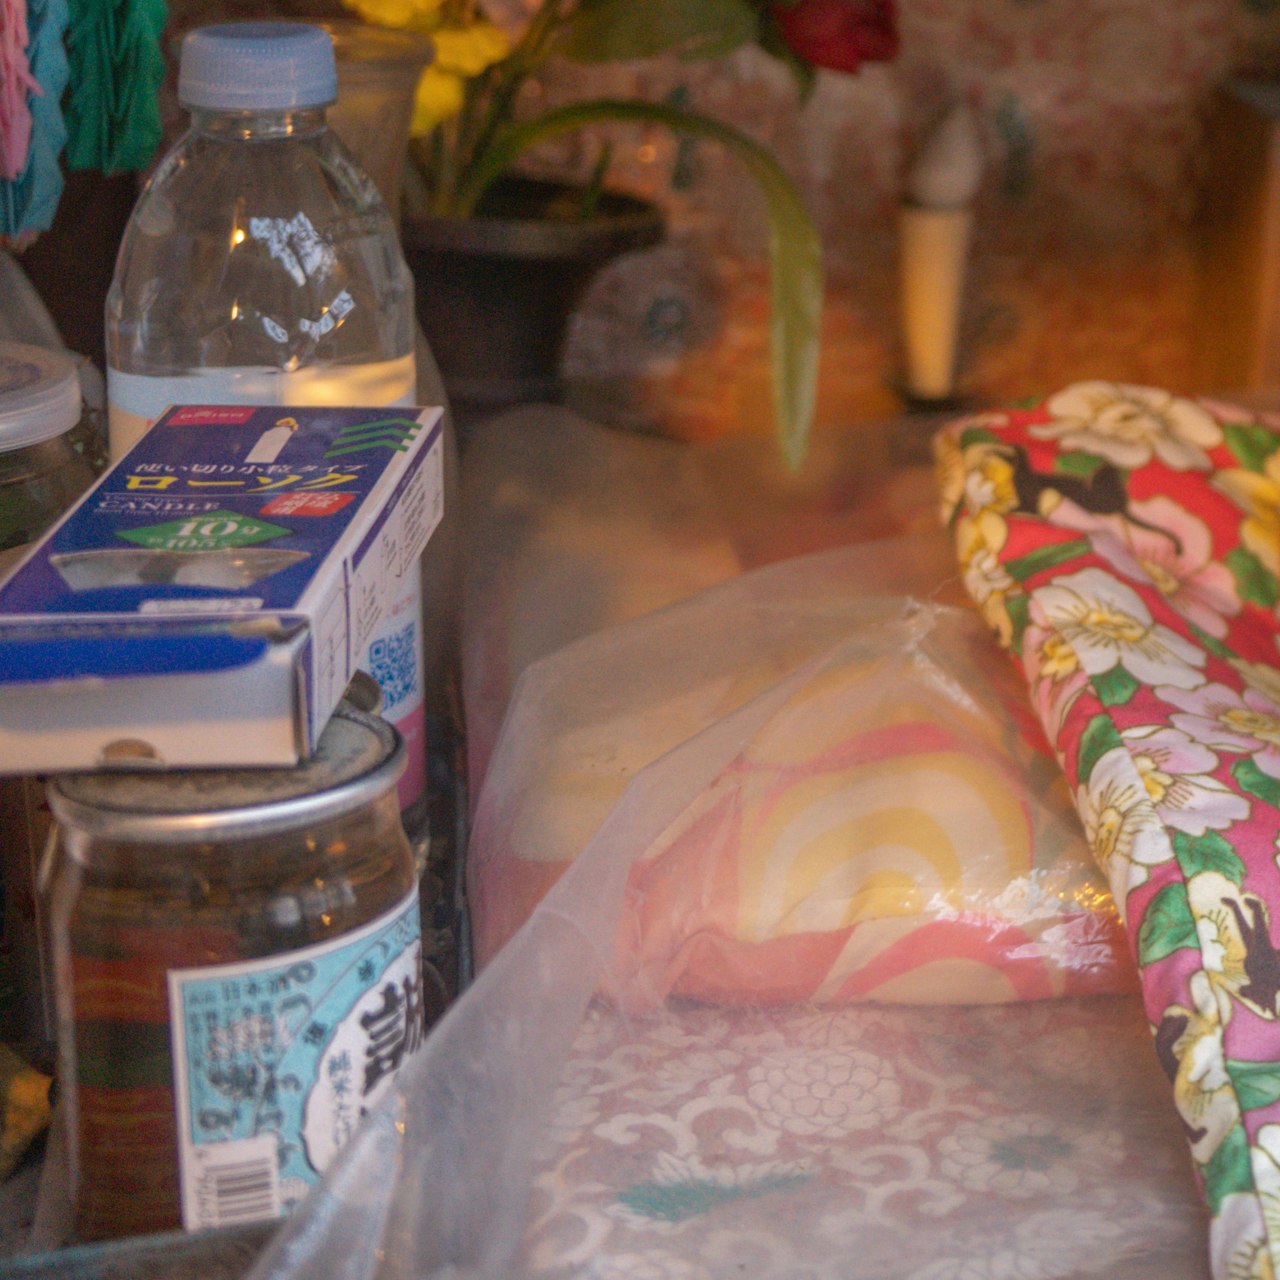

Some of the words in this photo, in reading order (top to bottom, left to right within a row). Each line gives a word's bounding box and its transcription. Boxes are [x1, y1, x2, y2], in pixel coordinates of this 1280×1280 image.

[126, 473, 360, 493] ローソク
[99, 501, 221, 511] CANDLE
